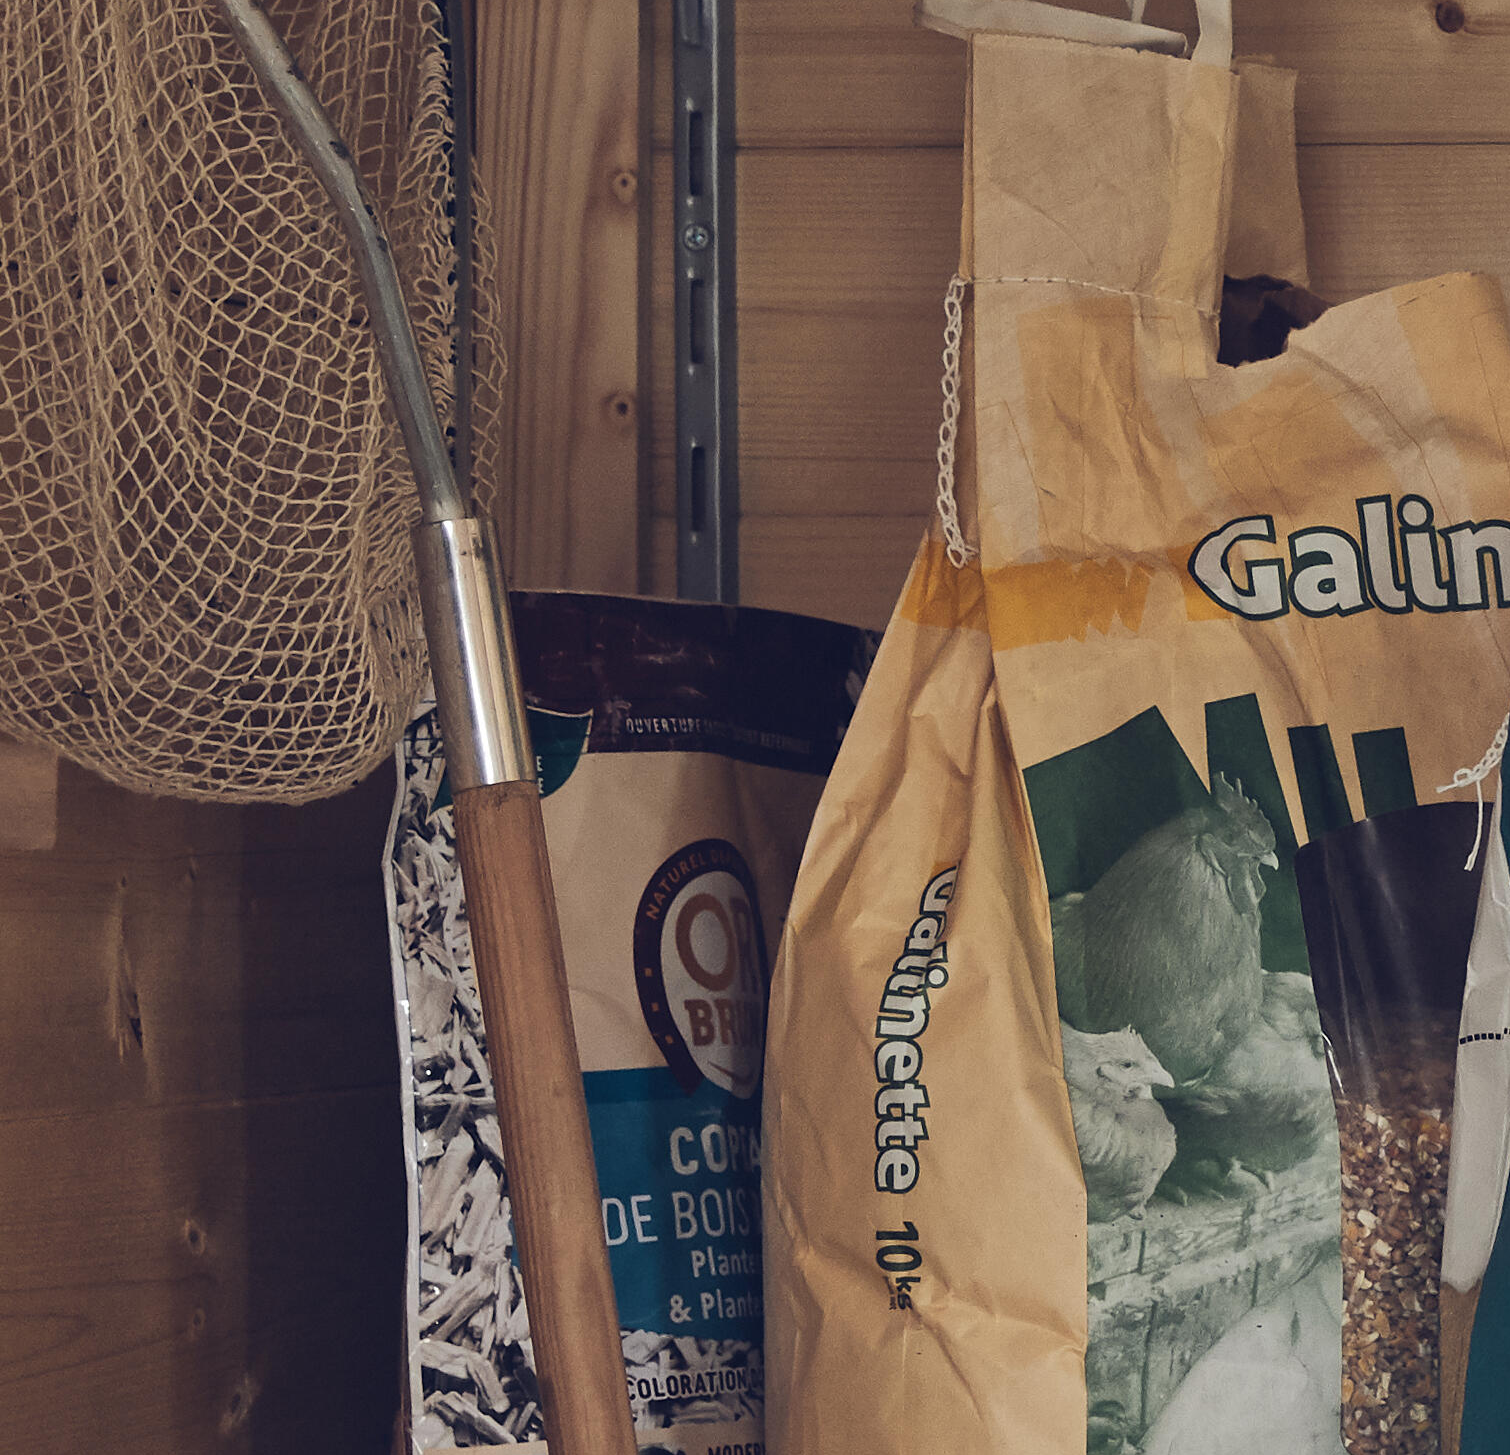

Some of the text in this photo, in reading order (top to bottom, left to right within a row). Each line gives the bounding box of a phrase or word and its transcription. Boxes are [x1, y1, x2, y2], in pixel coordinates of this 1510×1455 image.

[645, 851, 706, 920] NATUREL
[602, 1188, 749, 1246] DE BOIS
[669, 1295, 693, 1323] &
